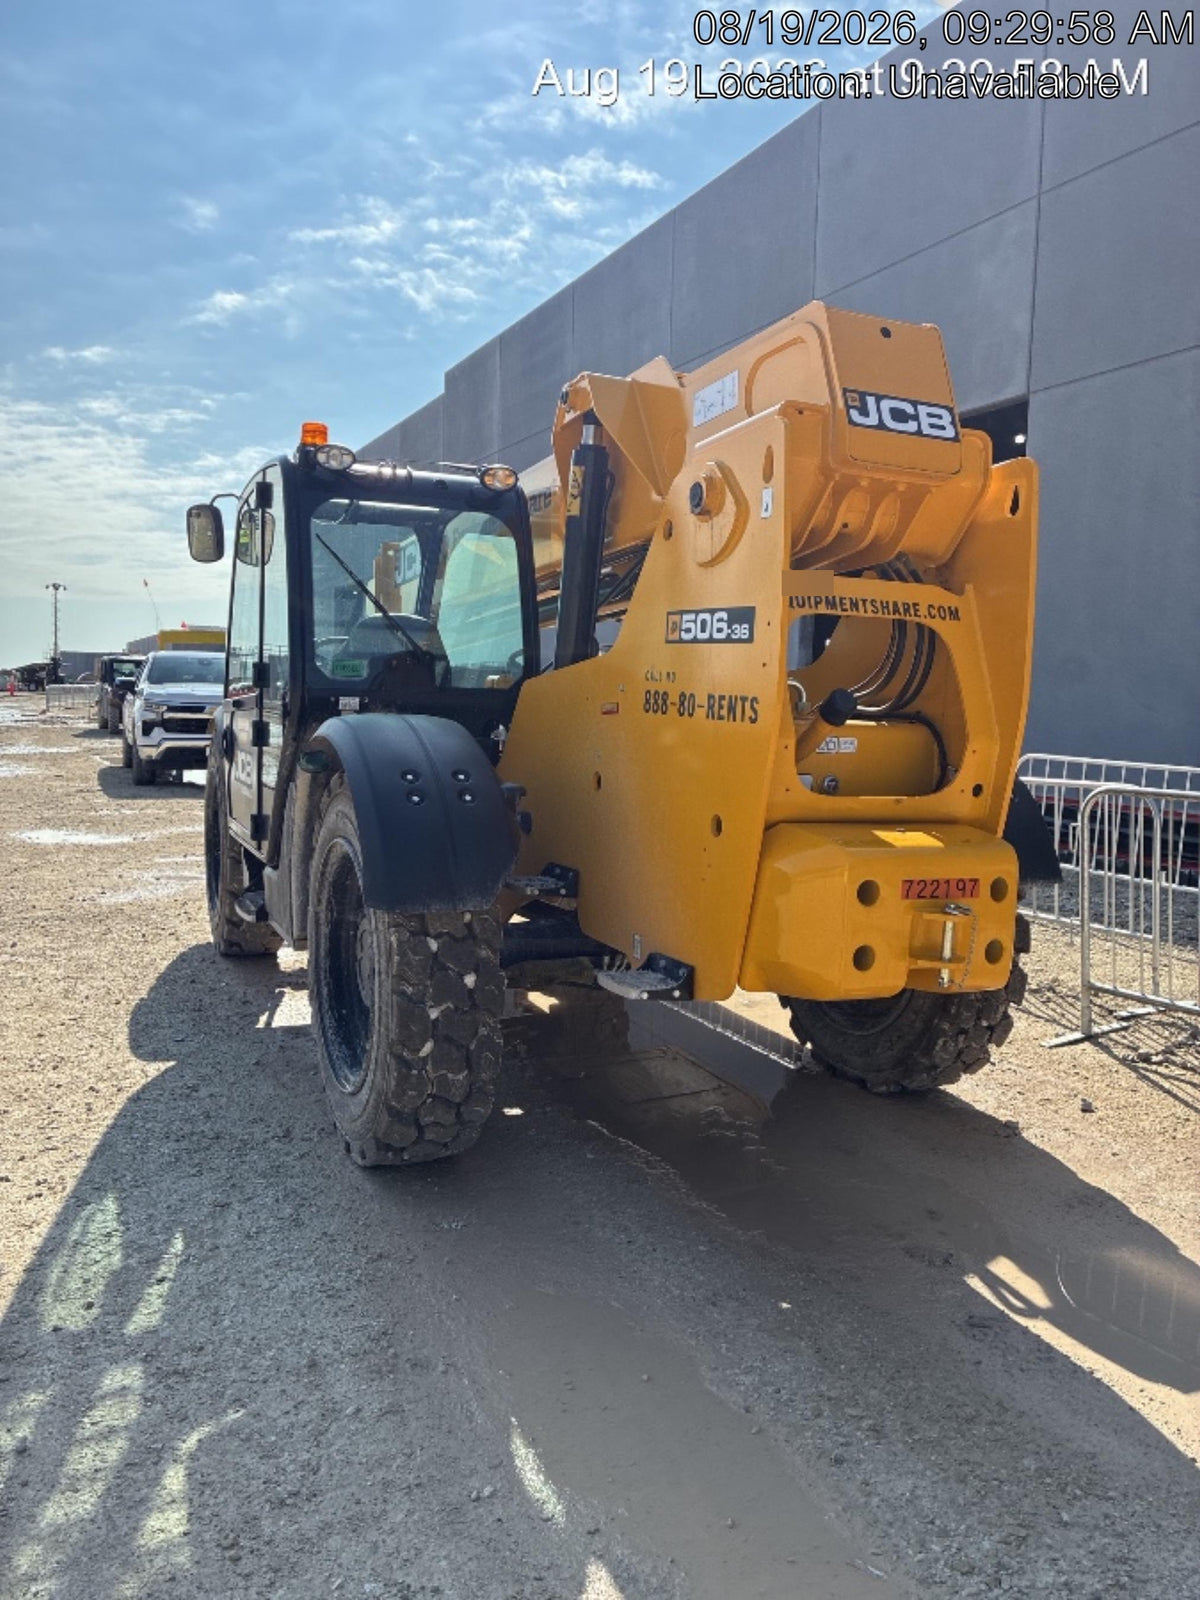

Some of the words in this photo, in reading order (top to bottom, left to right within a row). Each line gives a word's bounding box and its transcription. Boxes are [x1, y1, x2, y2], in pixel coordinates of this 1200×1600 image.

[849, 395, 956, 438] JCB
[643, 689, 759, 724] 888-80-RENTS
[903, 878, 979, 899] 722197
